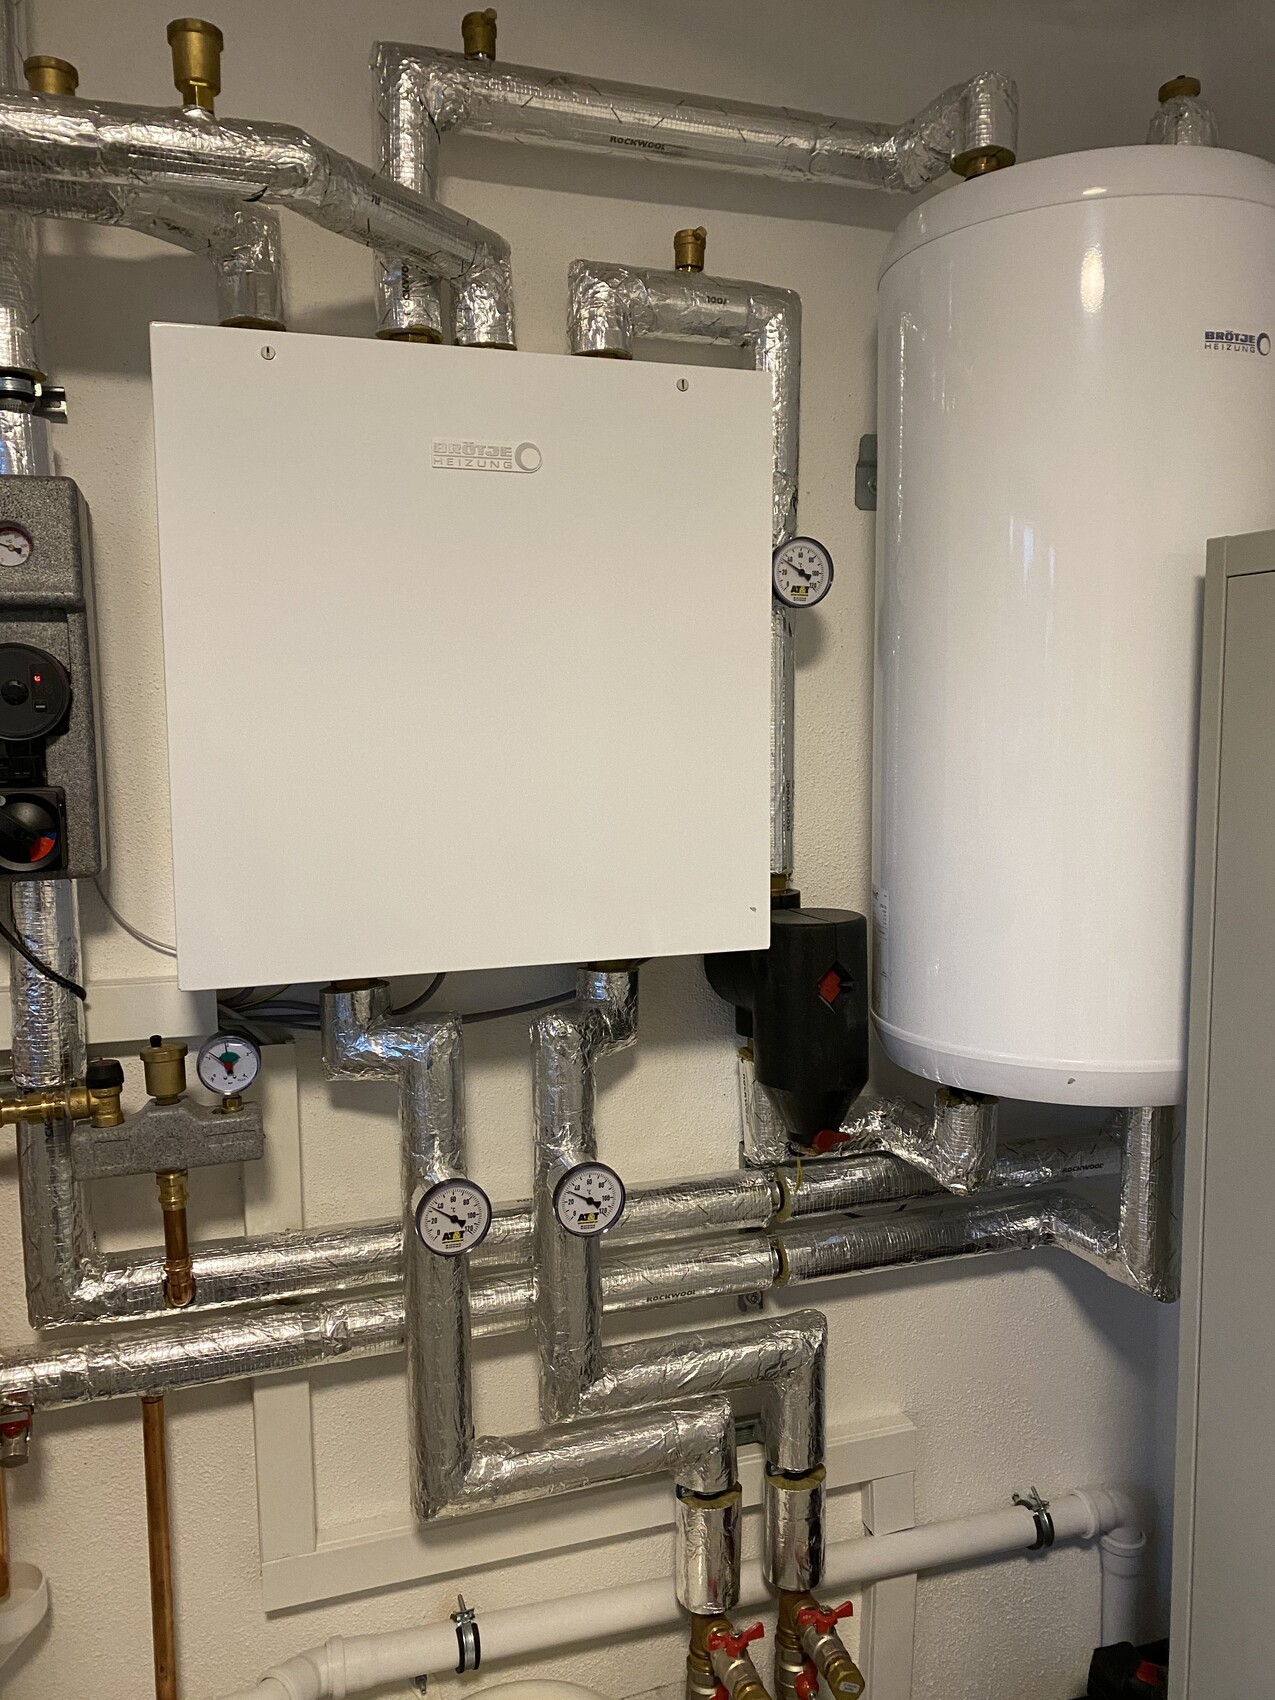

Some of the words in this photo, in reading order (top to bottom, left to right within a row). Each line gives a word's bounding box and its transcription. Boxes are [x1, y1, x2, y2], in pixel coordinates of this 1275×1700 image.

[1205, 329, 1256, 344] BRÖTJE
[1204, 343, 1256, 354] HEIZUNG
[433, 441, 512, 458] BRÖTJE
[433, 457, 513, 470] HEIZUNG
[577, 1211, 600, 1221] AT&T
[442, 1230, 466, 1241] AT&T
